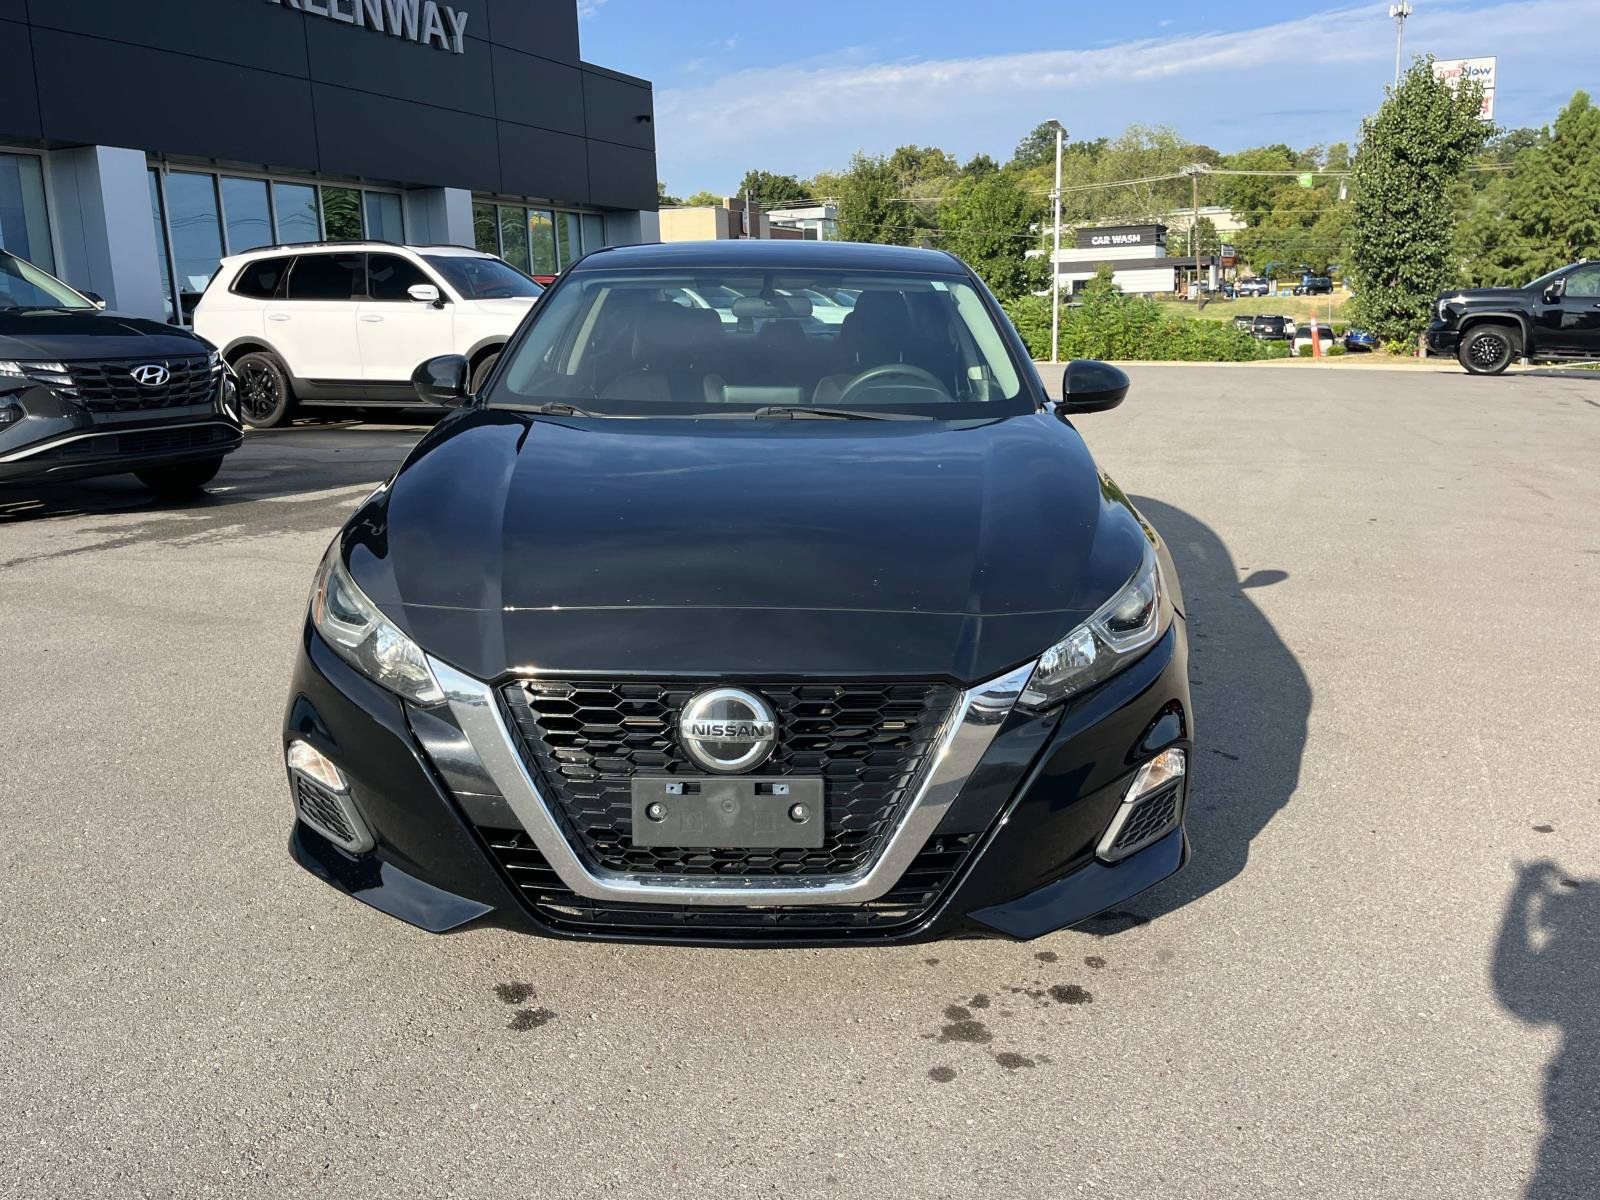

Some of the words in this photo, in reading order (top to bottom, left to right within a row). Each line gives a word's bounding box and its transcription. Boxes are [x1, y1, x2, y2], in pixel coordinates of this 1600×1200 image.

[1091, 235, 1111, 245] CAR
[1111, 234, 1141, 244] WASH
[692, 724, 764, 737] NISSAN
